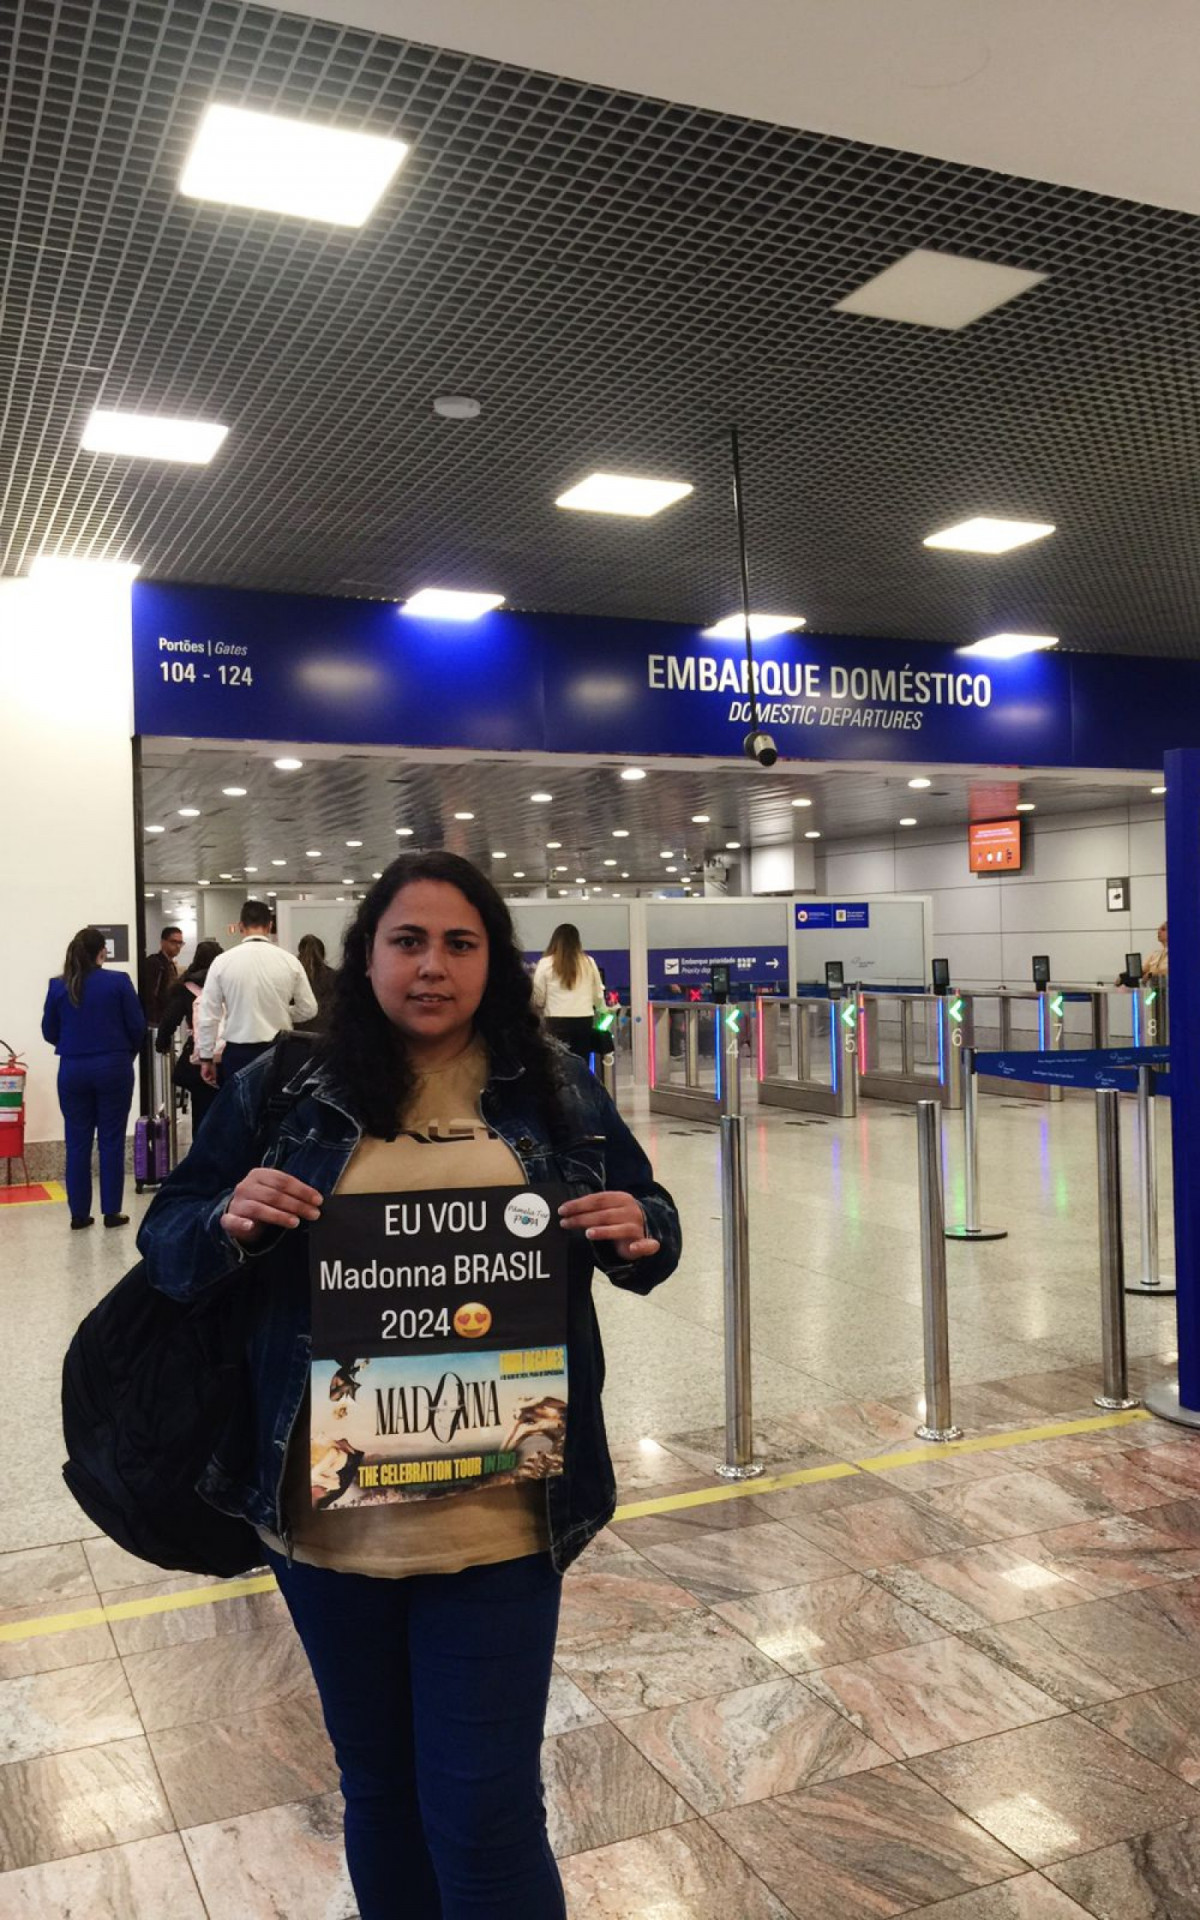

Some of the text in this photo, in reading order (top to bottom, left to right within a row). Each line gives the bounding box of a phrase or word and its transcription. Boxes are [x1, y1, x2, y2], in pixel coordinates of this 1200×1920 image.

[159, 637, 205, 653] Portões
[214, 641, 248, 657] Gates
[159, 661, 196, 684] 104
[218, 664, 253, 687] 124
[647, 653, 992, 709] EMBARQUE DOMÉSTICO
[728, 702, 924, 731] DOMESTIC DEPARTURES
[952, 1029, 962, 1047] 6
[1053, 1023, 1063, 1042] 7
[1147, 1020, 1157, 1037] 8
[726, 1040, 739, 1058] 4
[844, 1035, 855, 1053] 5
[384, 1200, 487, 1236] EU VOU
[319, 1249, 551, 1291] Madonna BRASIL
[381, 1307, 451, 1340] 2024
[375, 1371, 502, 1444] MADONNA
[357, 1465, 380, 1488] THE
[380, 1459, 452, 1487] CELEBRATION
[454, 1456, 482, 1479] TOUR
